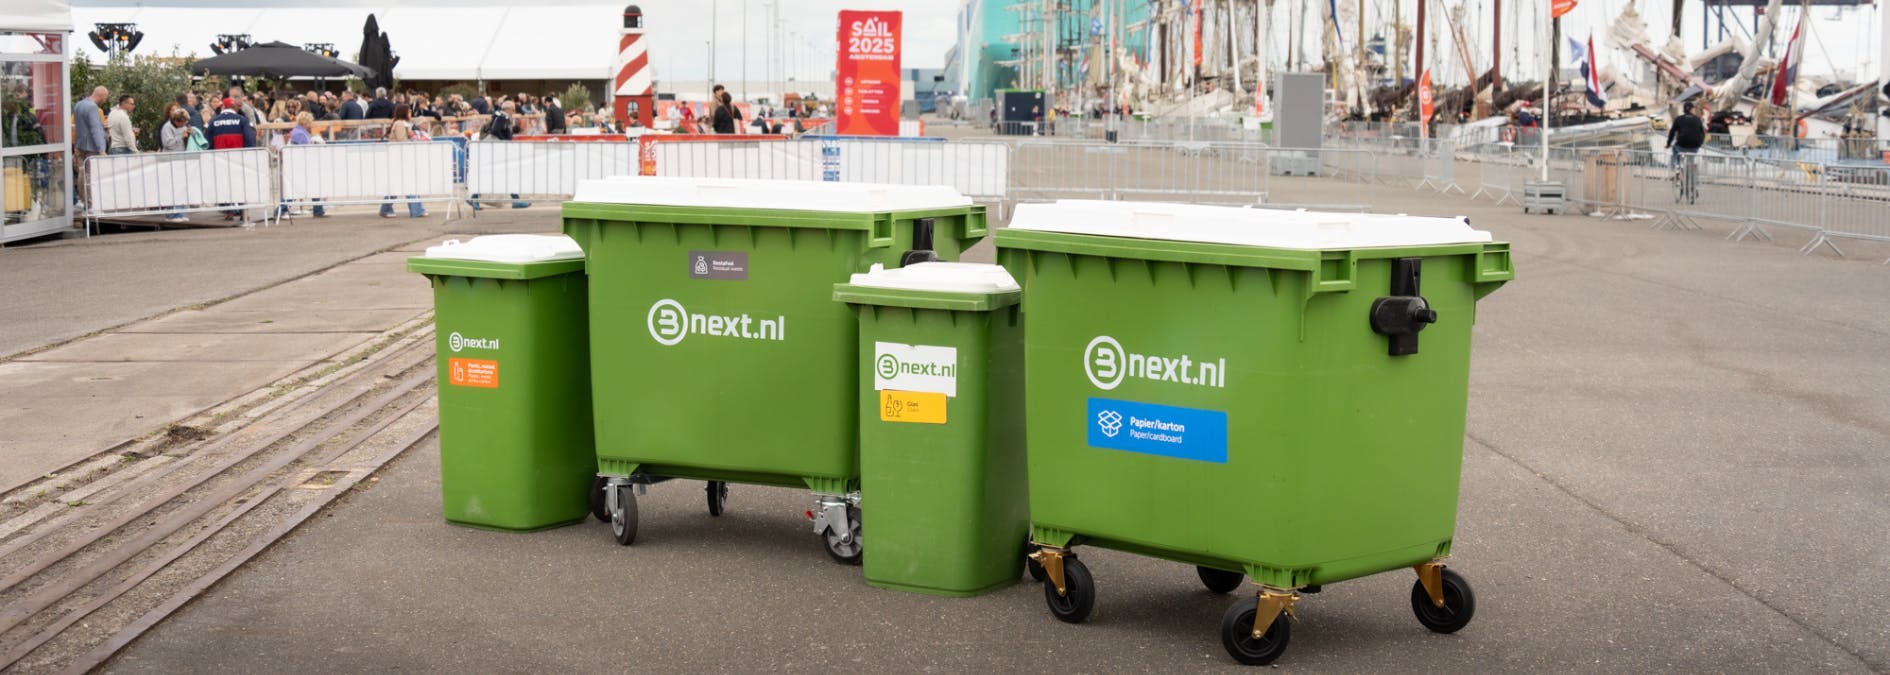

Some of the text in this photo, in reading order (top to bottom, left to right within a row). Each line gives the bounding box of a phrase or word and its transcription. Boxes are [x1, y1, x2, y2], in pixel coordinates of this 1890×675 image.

[851, 16, 893, 37] SAIL
[848, 37, 895, 54] 2025
[213, 119, 241, 127] CREW
[1129, 416, 1185, 433] Papier/karton
[1129, 429, 1183, 444] Paper/cardboard
